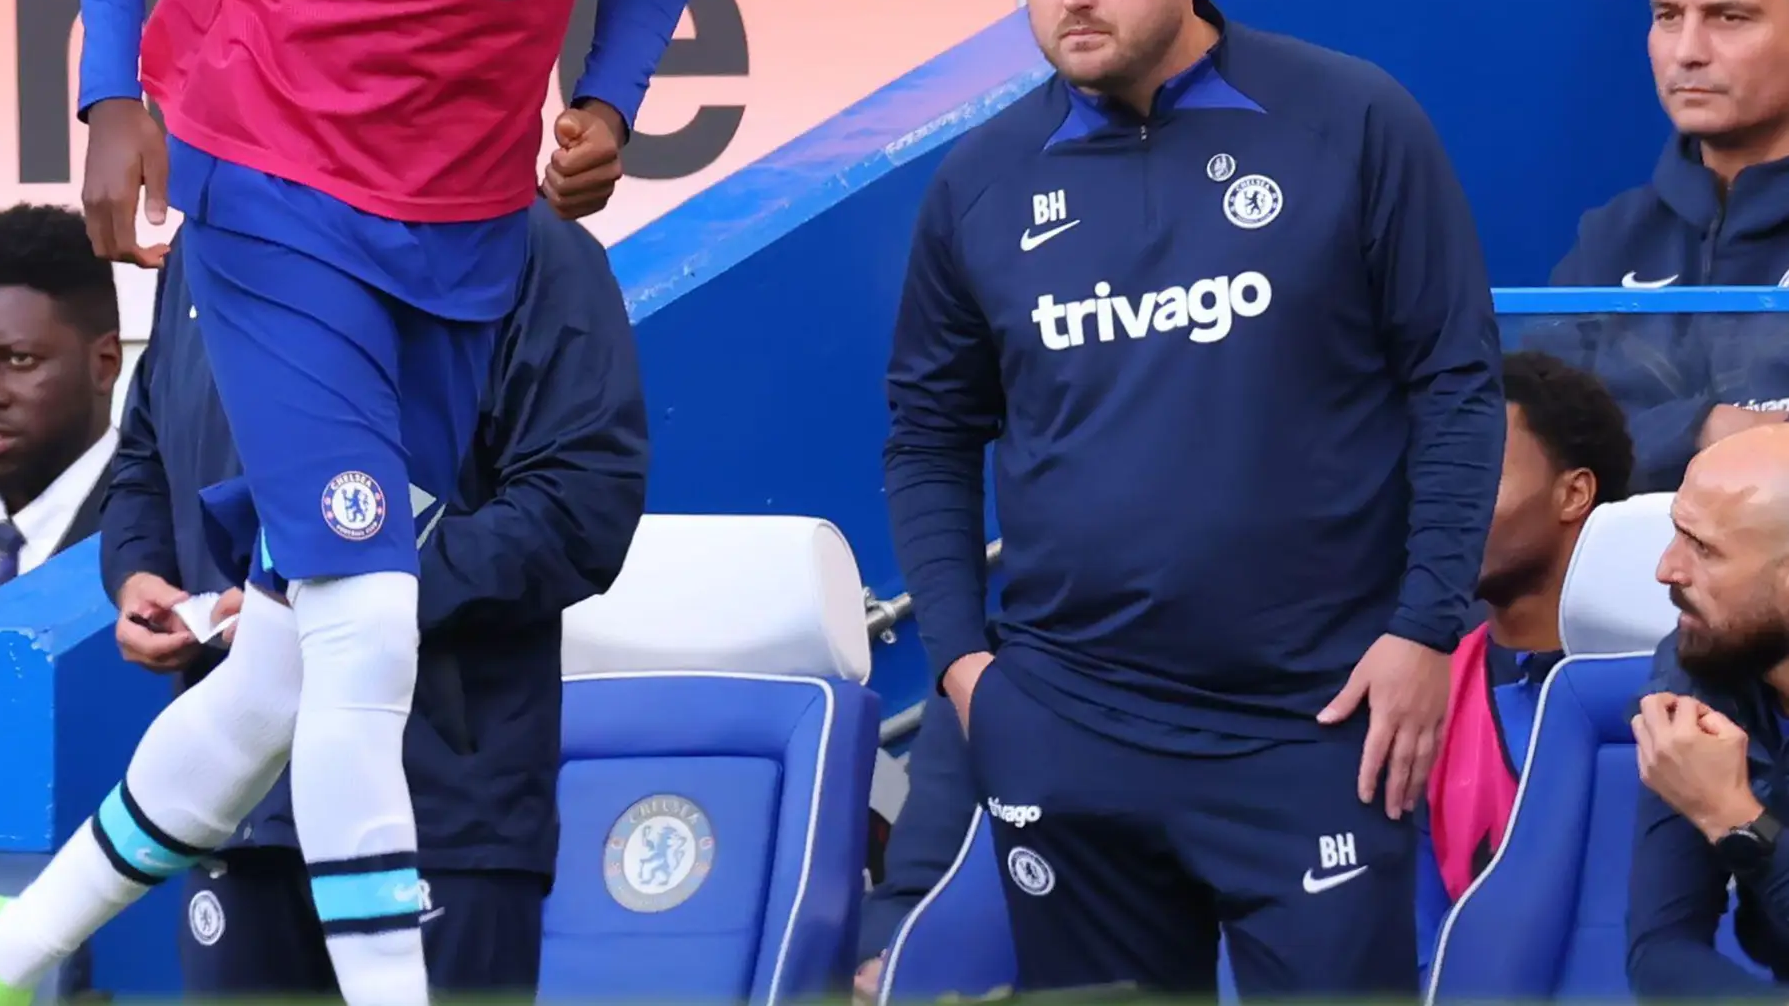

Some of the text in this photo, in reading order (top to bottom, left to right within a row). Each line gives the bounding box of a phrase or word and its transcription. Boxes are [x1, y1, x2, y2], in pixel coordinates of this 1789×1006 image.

[1033, 190, 1067, 225] BH
[1031, 270, 1272, 351] trivago
[1319, 832, 1357, 869] BH
